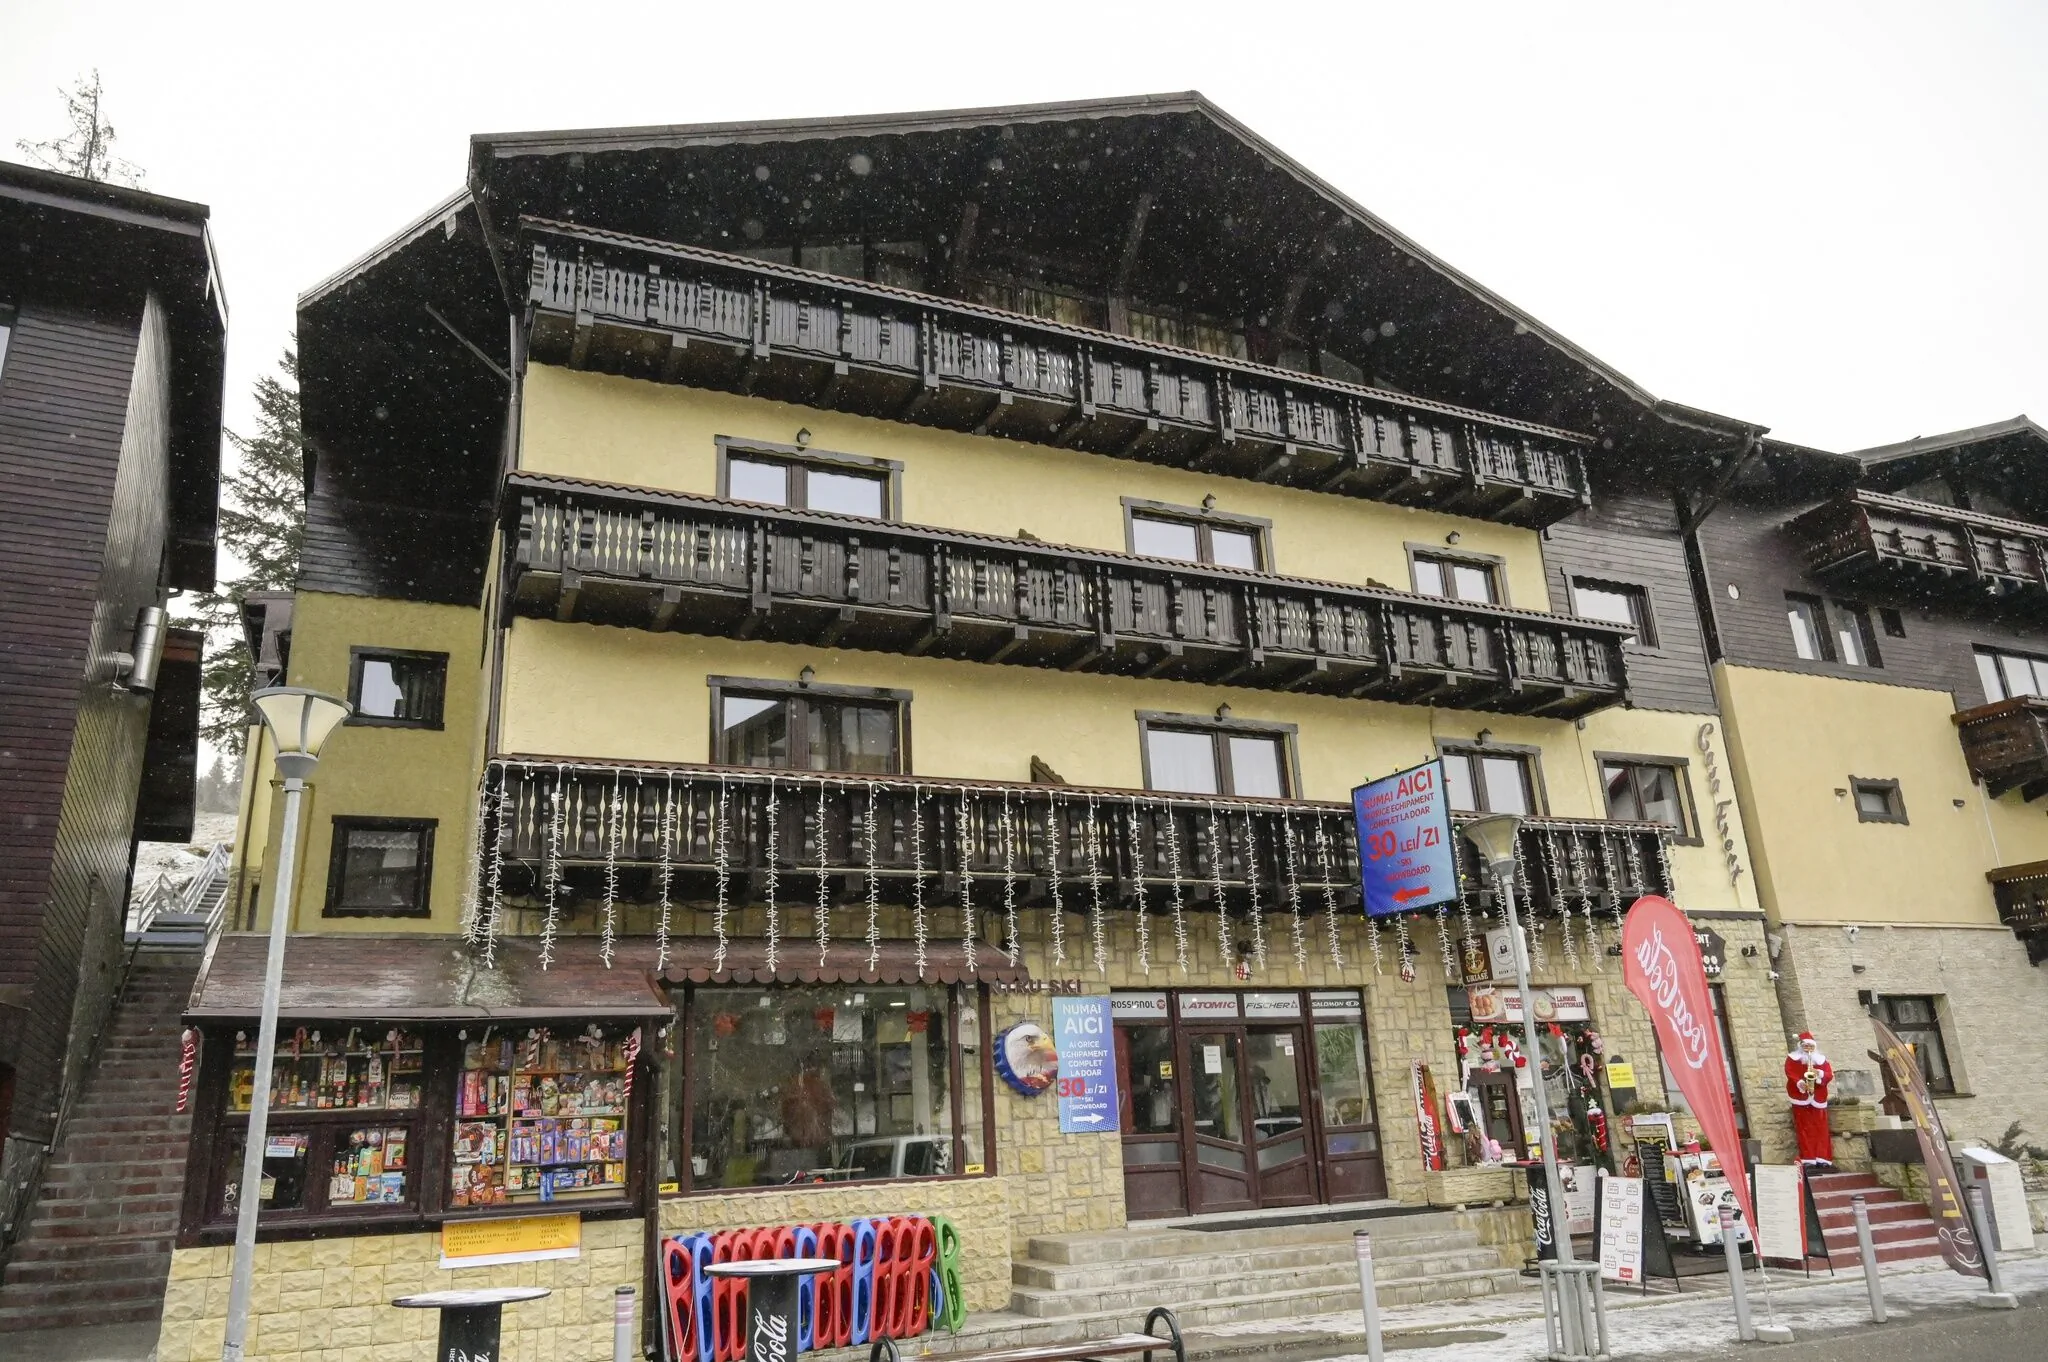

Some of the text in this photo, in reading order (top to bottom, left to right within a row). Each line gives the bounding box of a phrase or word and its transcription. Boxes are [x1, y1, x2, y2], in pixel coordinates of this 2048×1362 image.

[1697, 722, 1721, 794] Casa
[1363, 768, 1433, 809] NUMAI AICI
[1390, 792, 1435, 813] ECHIPAMENT
[1369, 805, 1431, 831] COMPLET LA DOAR
[1368, 830, 1397, 862] 30
[1048, 978, 1082, 994] SKI
[1062, 1003, 1102, 1016] NUMAI
[1112, 1000, 1155, 1010] ROSSIGNOL
[1188, 1001, 1236, 1009] ATOMIC
[1064, 1016, 1103, 1034] AICI
[1069, 1040, 1100, 1049] AI ORICE
[1068, 1059, 1103, 1068] COMPLET
[1081, 1069, 1102, 1077] DOAR
[1058, 1076, 1085, 1098] 30
